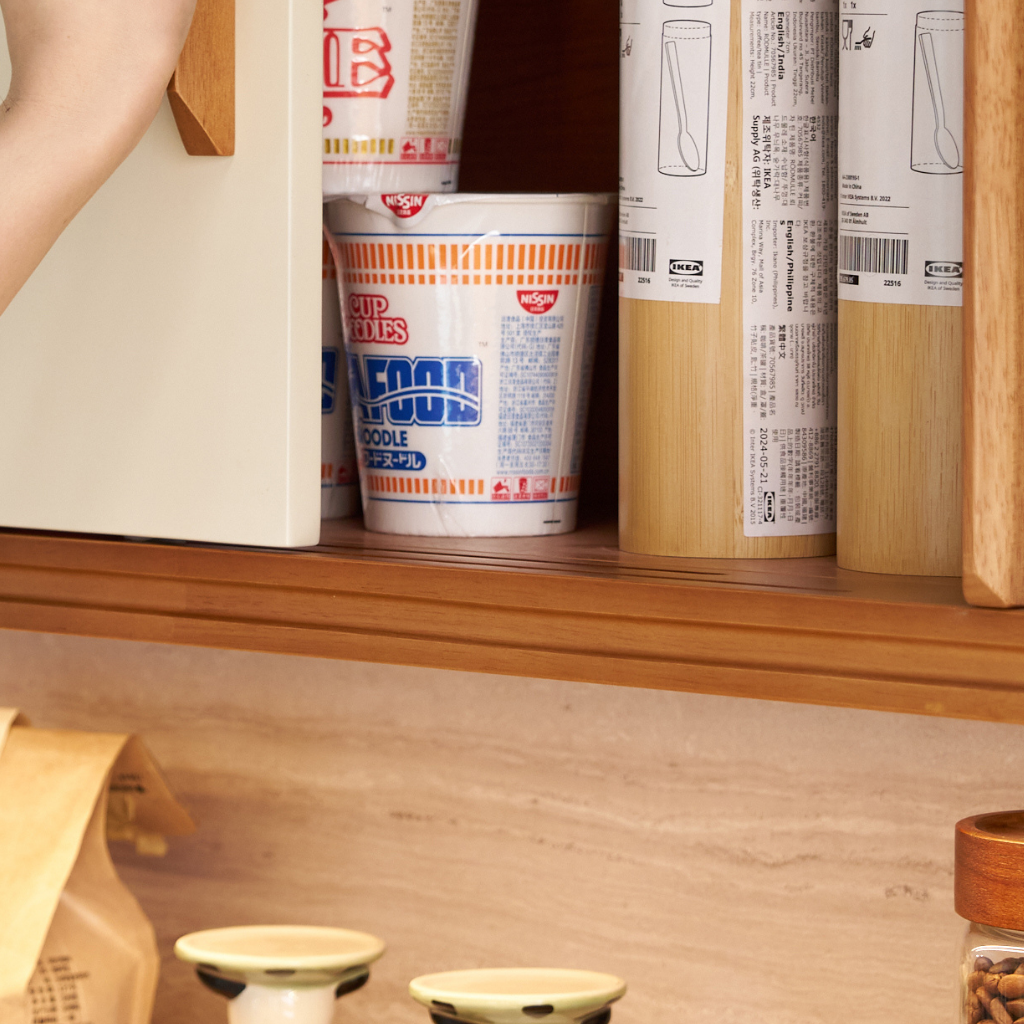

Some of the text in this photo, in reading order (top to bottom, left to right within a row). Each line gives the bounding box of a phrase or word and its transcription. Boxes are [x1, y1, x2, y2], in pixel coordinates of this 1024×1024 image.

[776, 11, 785, 80] English/India
[799, 43, 802, 51] no
[751, 115, 761, 162] Supply AG
[762, 115, 771, 189] 제조위탁자: IKEA
[386, 194, 422, 209] NISSIN
[752, 268, 756, 276] 76
[785, 220, 794, 312] English/Philippine
[349, 295, 387, 318] CUP
[521, 292, 554, 306] NISSIN
[778, 325, 786, 359] 繁體中文
[760, 428, 768, 484] 2024-05-21
